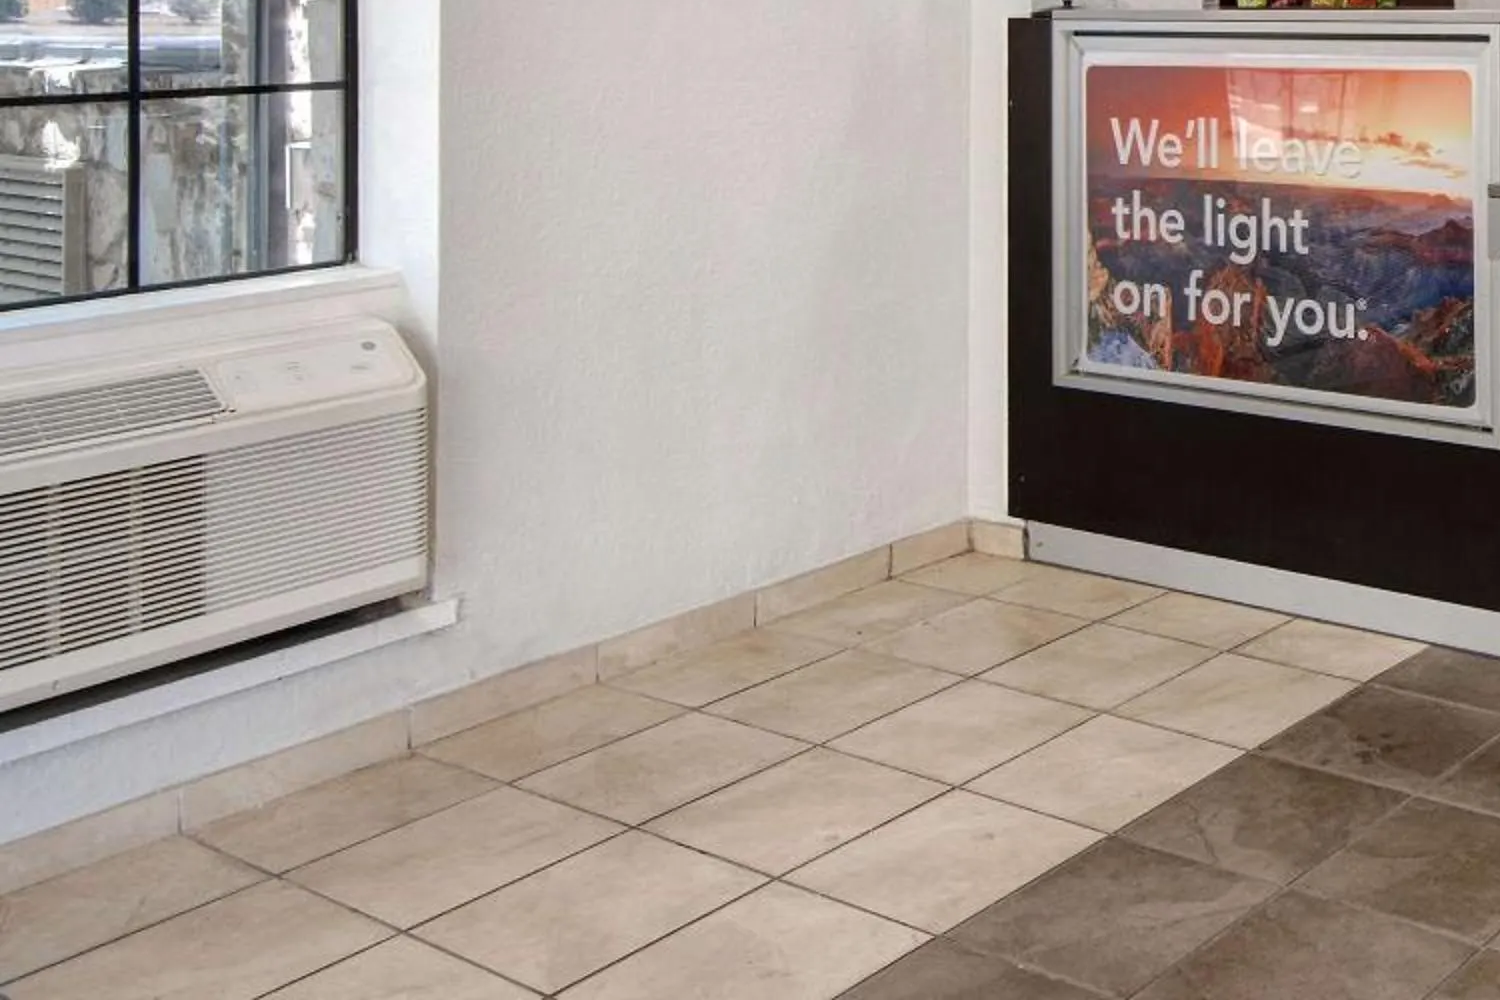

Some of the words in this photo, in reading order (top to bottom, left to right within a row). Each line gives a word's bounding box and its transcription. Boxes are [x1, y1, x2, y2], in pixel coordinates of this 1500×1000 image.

[1109, 116, 1219, 169] We'll
[1237, 117, 1363, 179] leave
[1111, 189, 1185, 244] the
[1203, 193, 1310, 265] light
[1113, 279, 1167, 318] on
[1184, 269, 1252, 327] for
